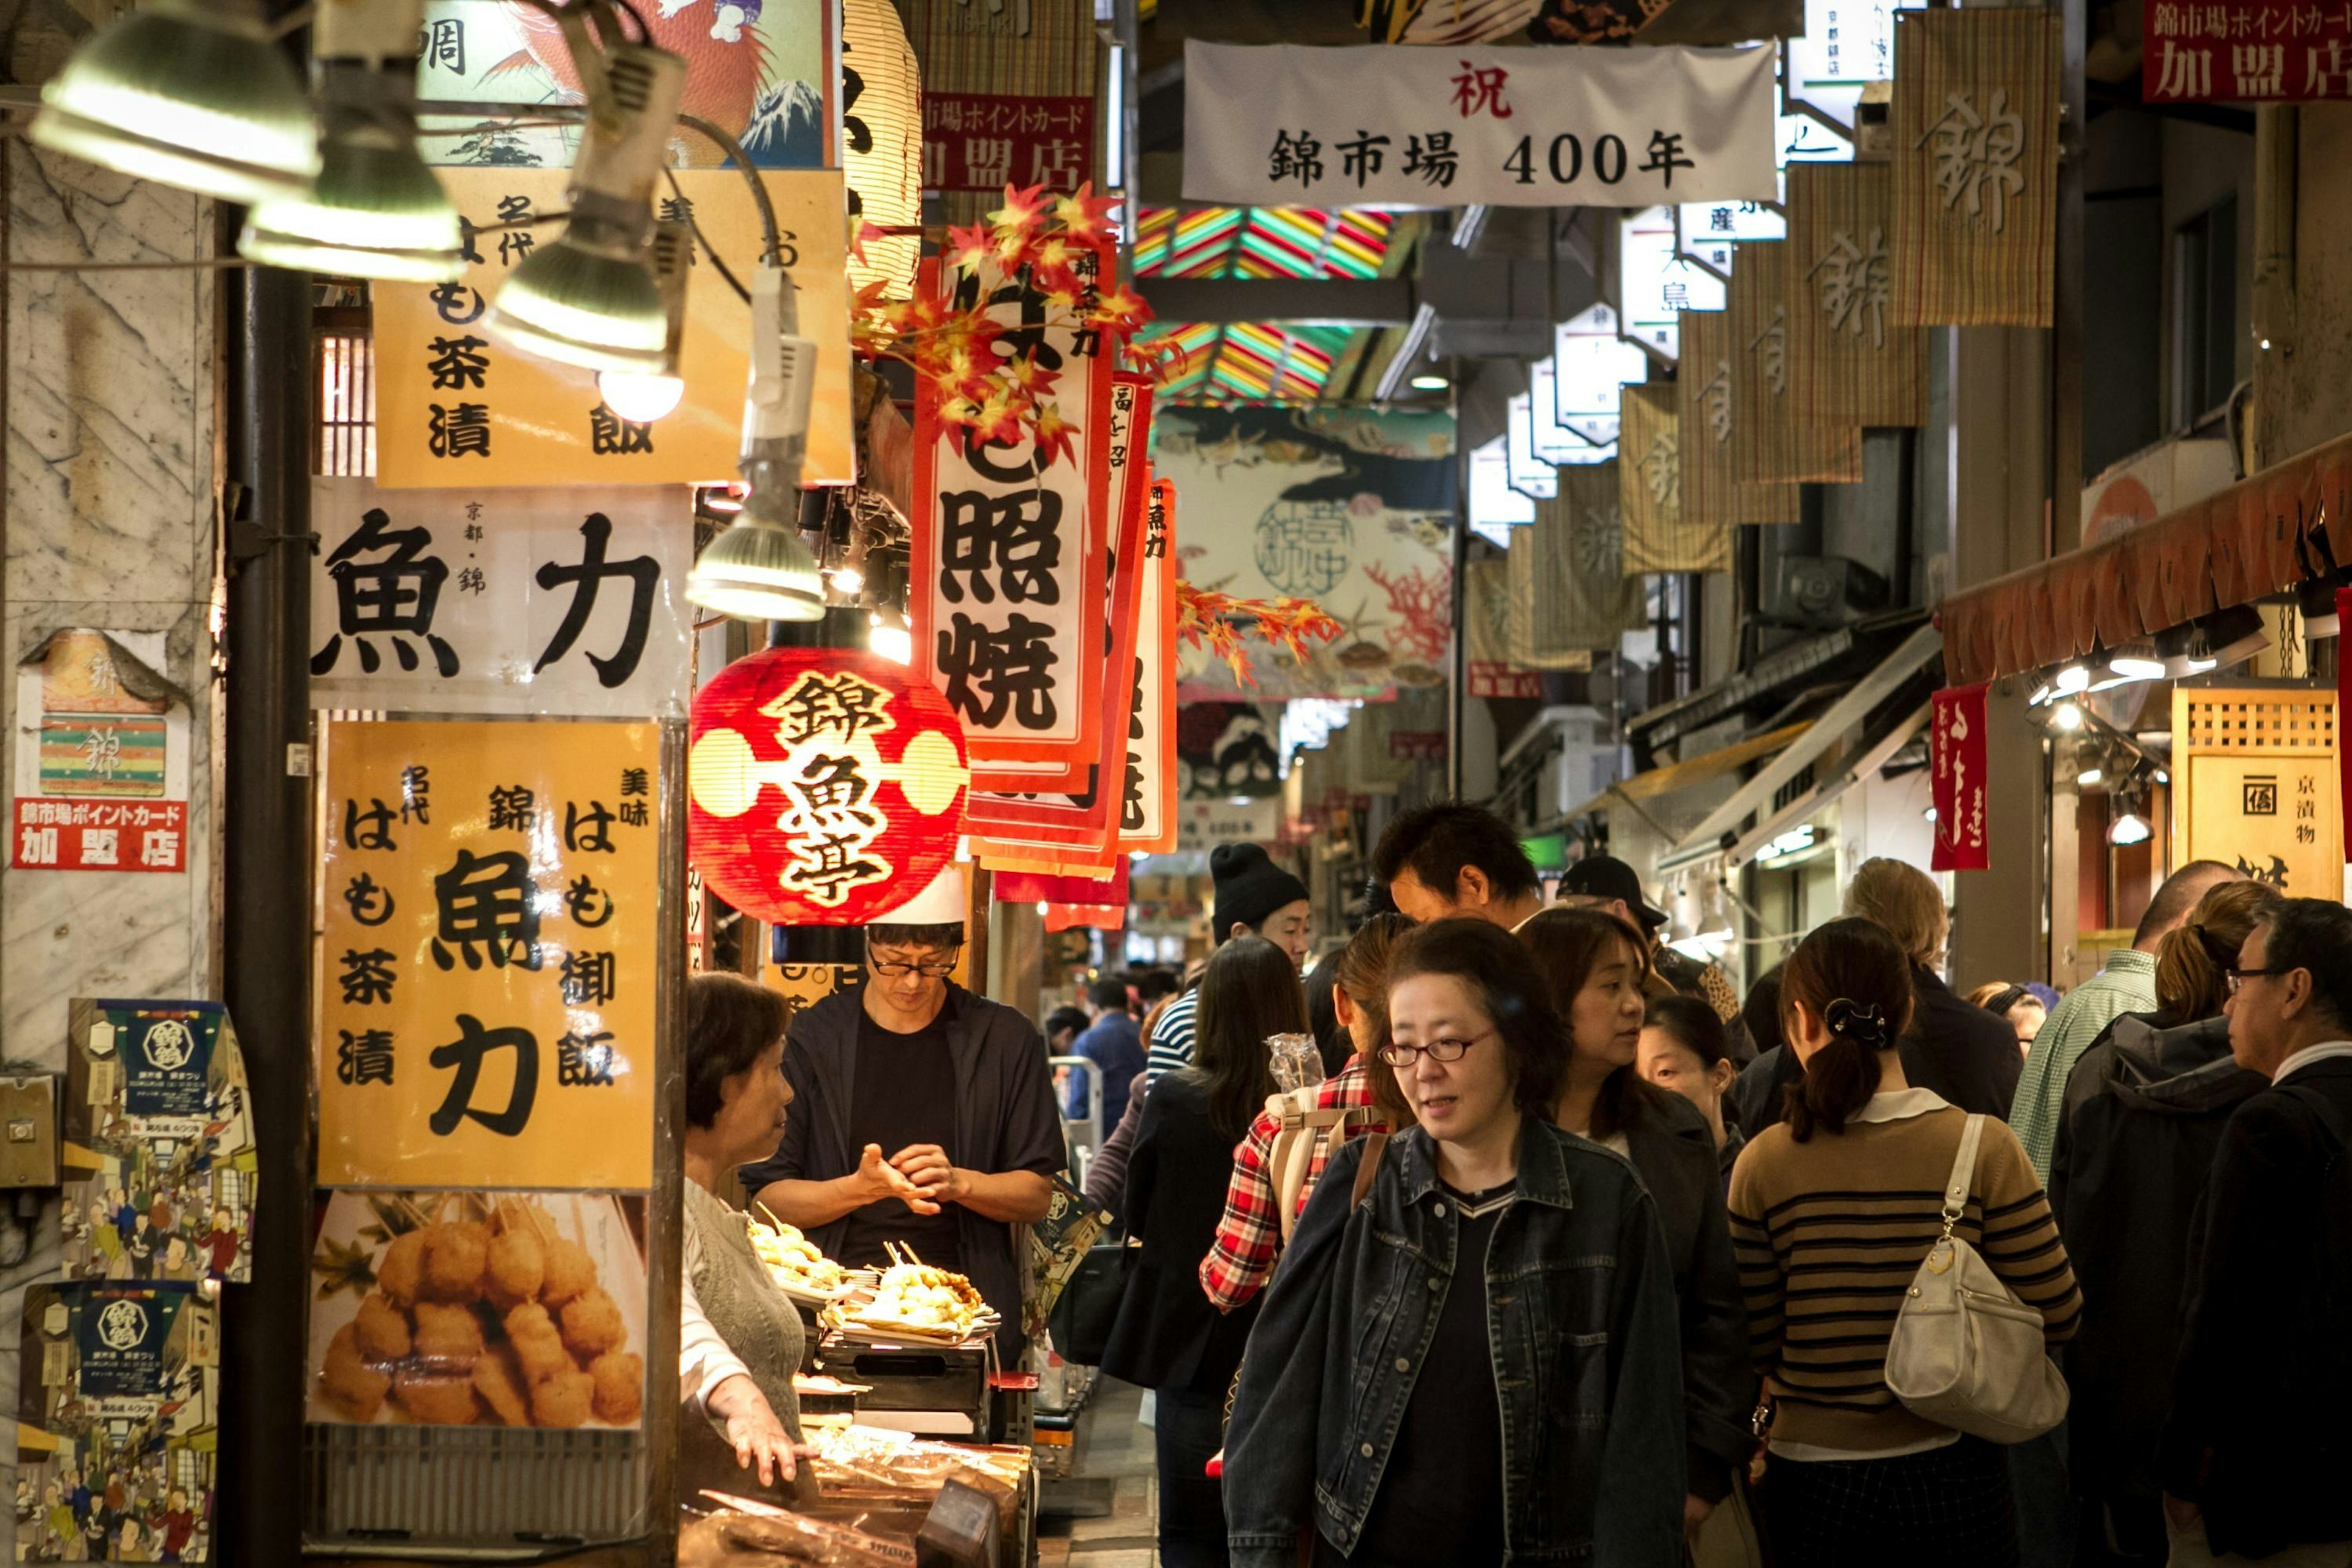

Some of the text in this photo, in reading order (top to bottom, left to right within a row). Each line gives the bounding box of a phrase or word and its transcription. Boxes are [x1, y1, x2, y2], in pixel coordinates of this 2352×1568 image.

[1450, 60, 1513, 119] 祝
[1268, 129, 1695, 189] 錦市場 400年
[497, 196, 535, 266] 名代
[458, 502, 486, 597] 京都・錦
[20, 802, 179, 826] 錦市場ポイントカード
[401, 766, 430, 825] 名代
[488, 785, 535, 832] 錦
[619, 768, 648, 827] 美味
[2296, 775, 2315, 844] 京漬物
[20, 827, 178, 867] 加盟店
[337, 798, 398, 1086] はも茶漬
[556, 801, 616, 1087] はも御飯
[431, 848, 543, 1137] 魚力
